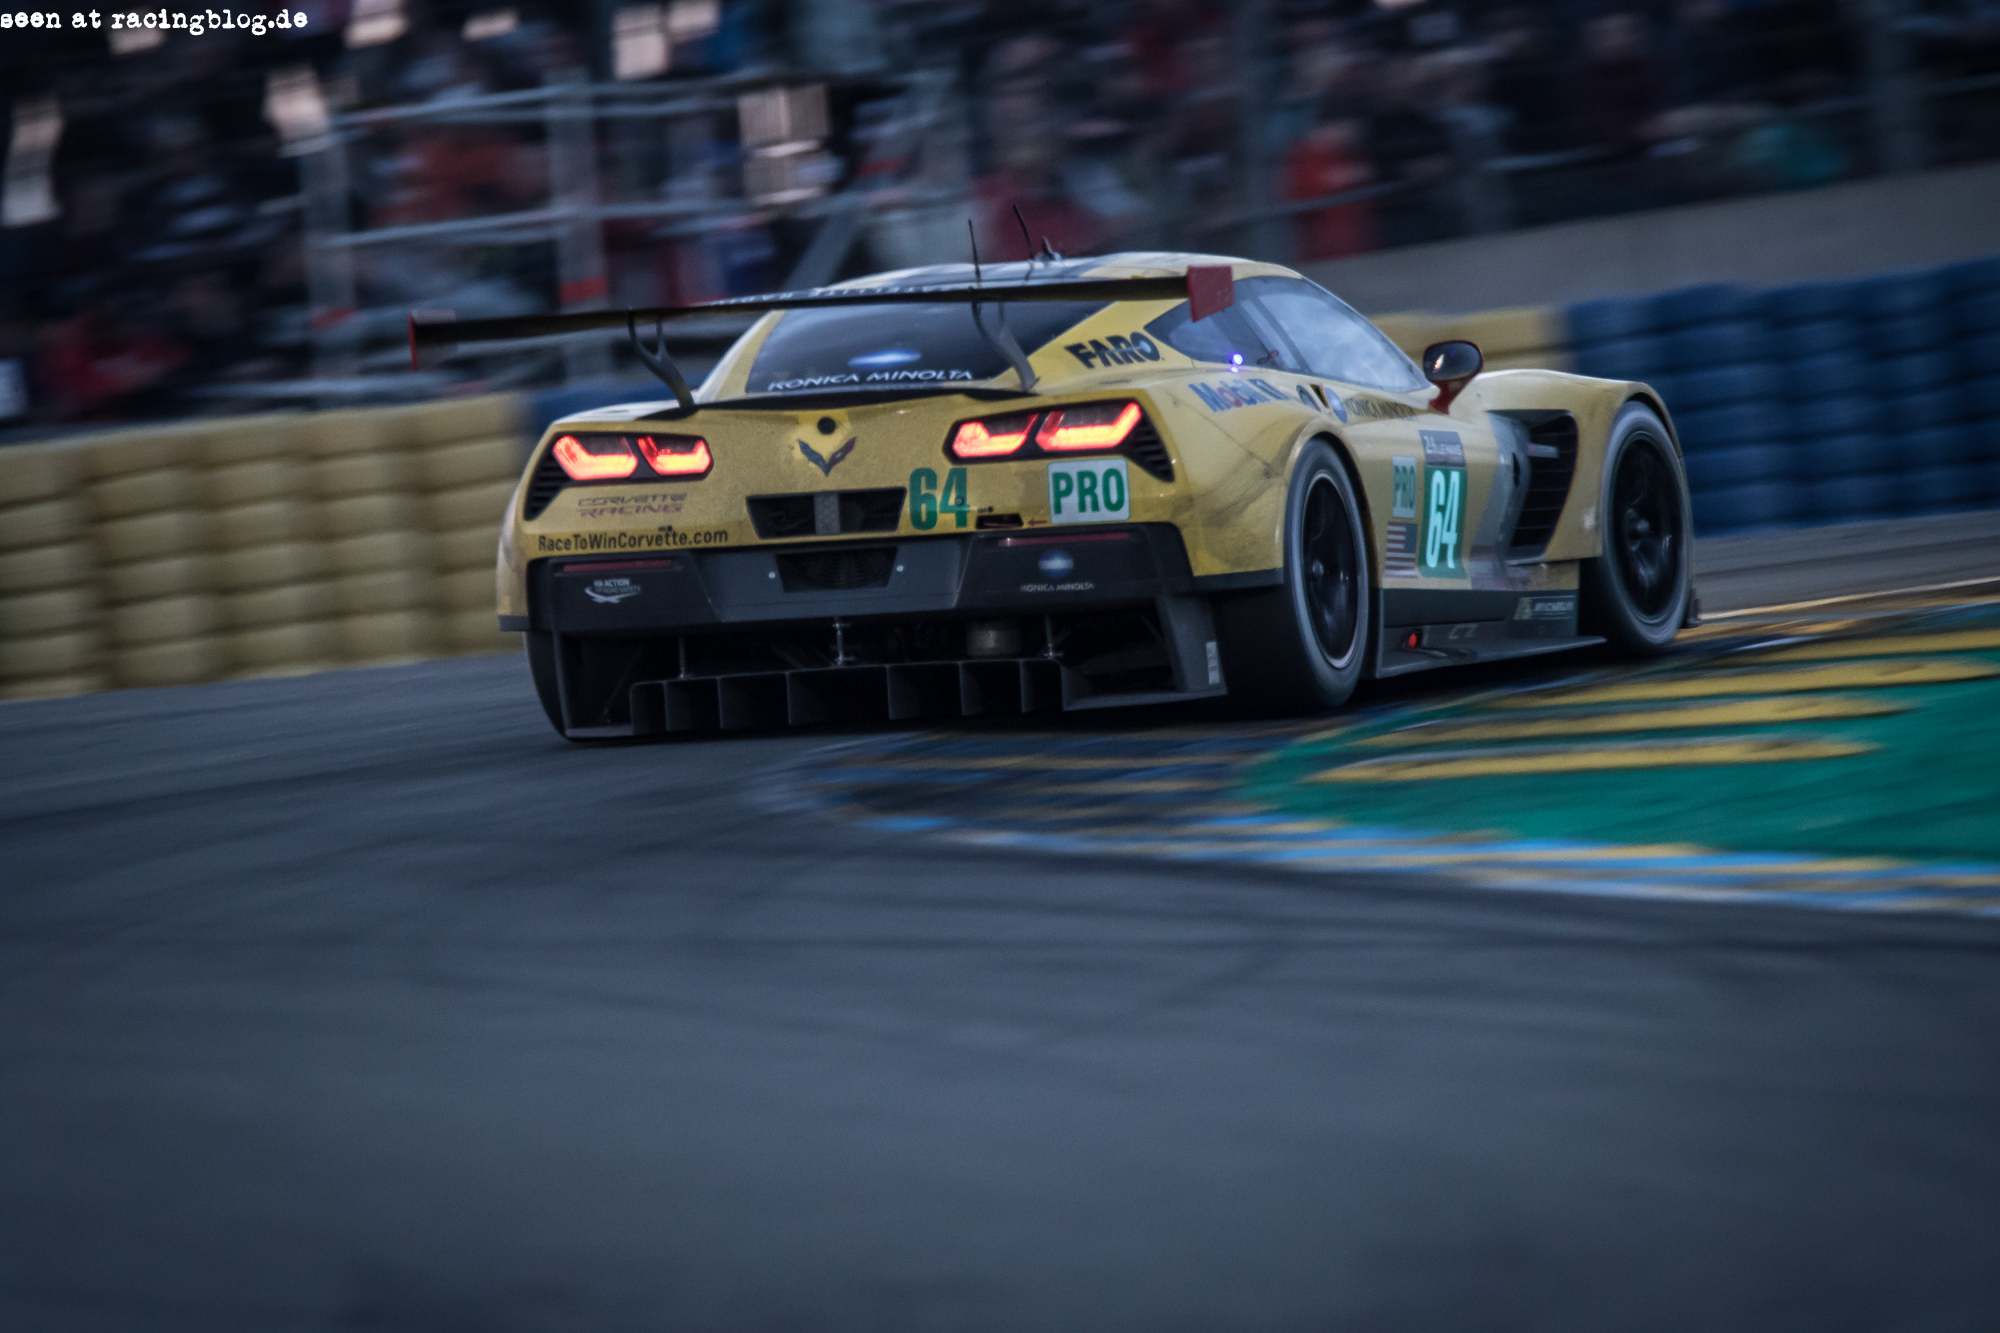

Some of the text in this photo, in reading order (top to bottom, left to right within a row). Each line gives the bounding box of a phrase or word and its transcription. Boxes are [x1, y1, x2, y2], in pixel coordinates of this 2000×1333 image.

[1064, 331, 1161, 369] FARO
[767, 369, 974, 392] KONICA MINOLTA
[578, 492, 688, 507] CORVETTE
[909, 467, 970, 530] 64
[1052, 467, 1126, 515] PRO
[1392, 464, 1416, 509] PRO
[578, 503, 685, 518] RACING
[1425, 469, 1461, 570] 64
[538, 527, 729, 552] RaceToWinCorvette.com
